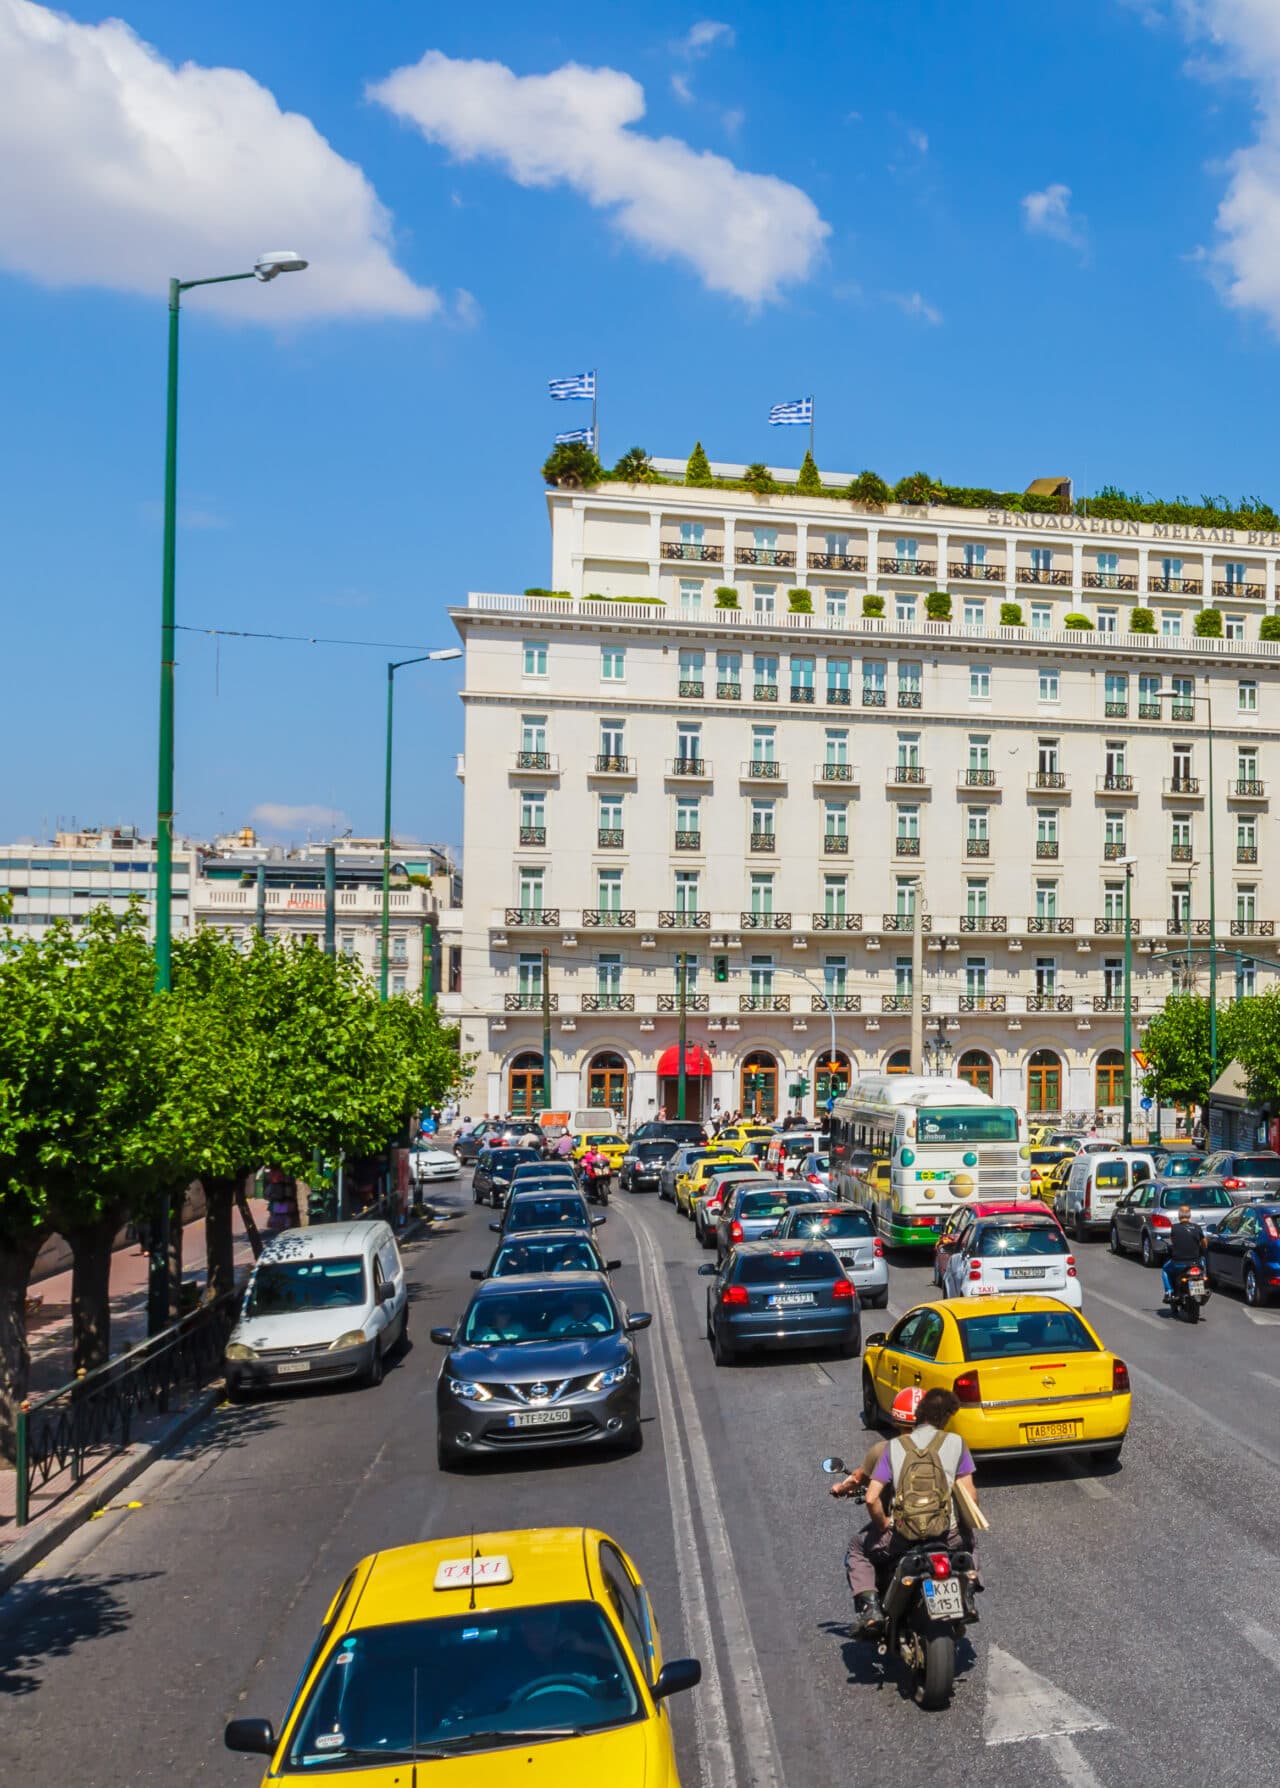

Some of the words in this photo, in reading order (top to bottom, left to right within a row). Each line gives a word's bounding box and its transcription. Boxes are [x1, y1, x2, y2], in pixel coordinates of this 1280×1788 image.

[986, 509, 1141, 536] ΞΕΝΟΔΟΧΕΙΟΝ
[977, 1285, 995, 1293] TAXI
[444, 1562, 502, 1578] TAXI
[937, 1597, 960, 1611] 151
